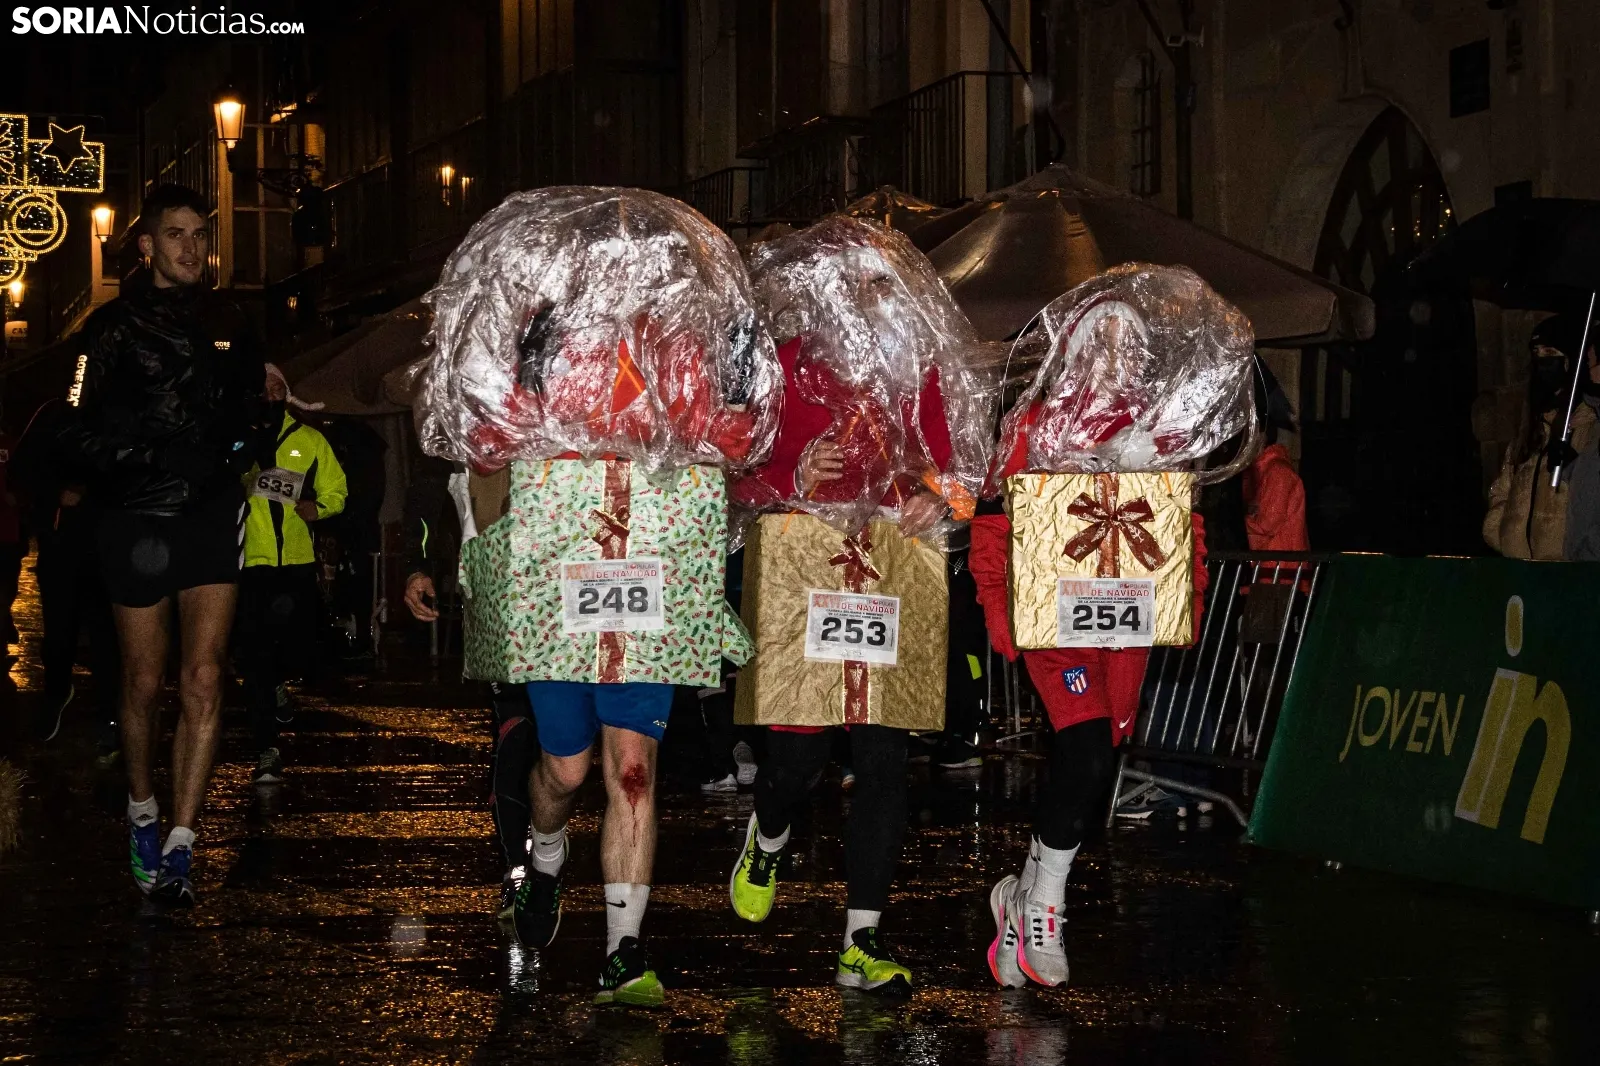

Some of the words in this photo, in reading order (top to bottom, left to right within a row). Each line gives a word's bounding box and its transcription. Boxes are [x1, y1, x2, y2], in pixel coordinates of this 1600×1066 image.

[257, 476, 295, 497] 633
[613, 569, 657, 578] NAVIDAD
[578, 586, 649, 614] 248
[1091, 589, 1103, 597] DE
[1107, 589, 1150, 597] NAVIDAD
[841, 602, 854, 610] DE
[856, 604, 895, 614] NAVIDAD
[1072, 604, 1141, 631] 254
[821, 616, 887, 646] 253
[1337, 684, 1466, 764] JOVEN
[1454, 594, 1572, 845] in
